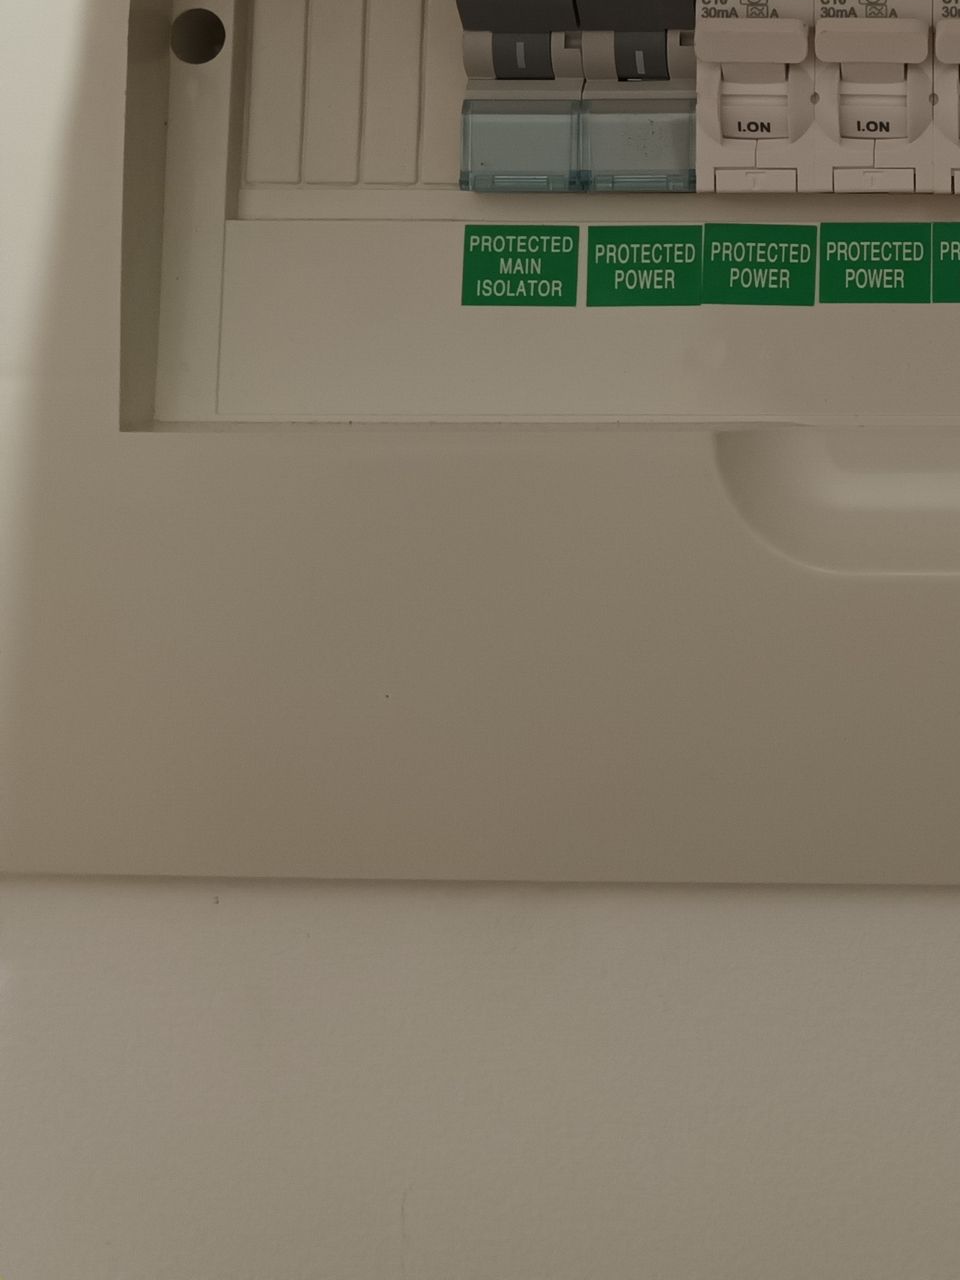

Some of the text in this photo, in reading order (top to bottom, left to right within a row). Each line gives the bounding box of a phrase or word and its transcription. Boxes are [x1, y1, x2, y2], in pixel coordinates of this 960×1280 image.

[701, 7, 739, 18] 30mA
[820, 7, 858, 18] 30mA
[469, 236, 574, 253] PROTECTED
[595, 243, 695, 264] PROTECTED
[711, 242, 811, 263] PROTECTED
[826, 241, 924, 262] PROTECTED
[499, 258, 542, 275] MAIN
[477, 279, 562, 297] ISOLATOR
[614, 270, 675, 290] POWER
[730, 268, 790, 289] POWER
[845, 268, 905, 288] POWER
